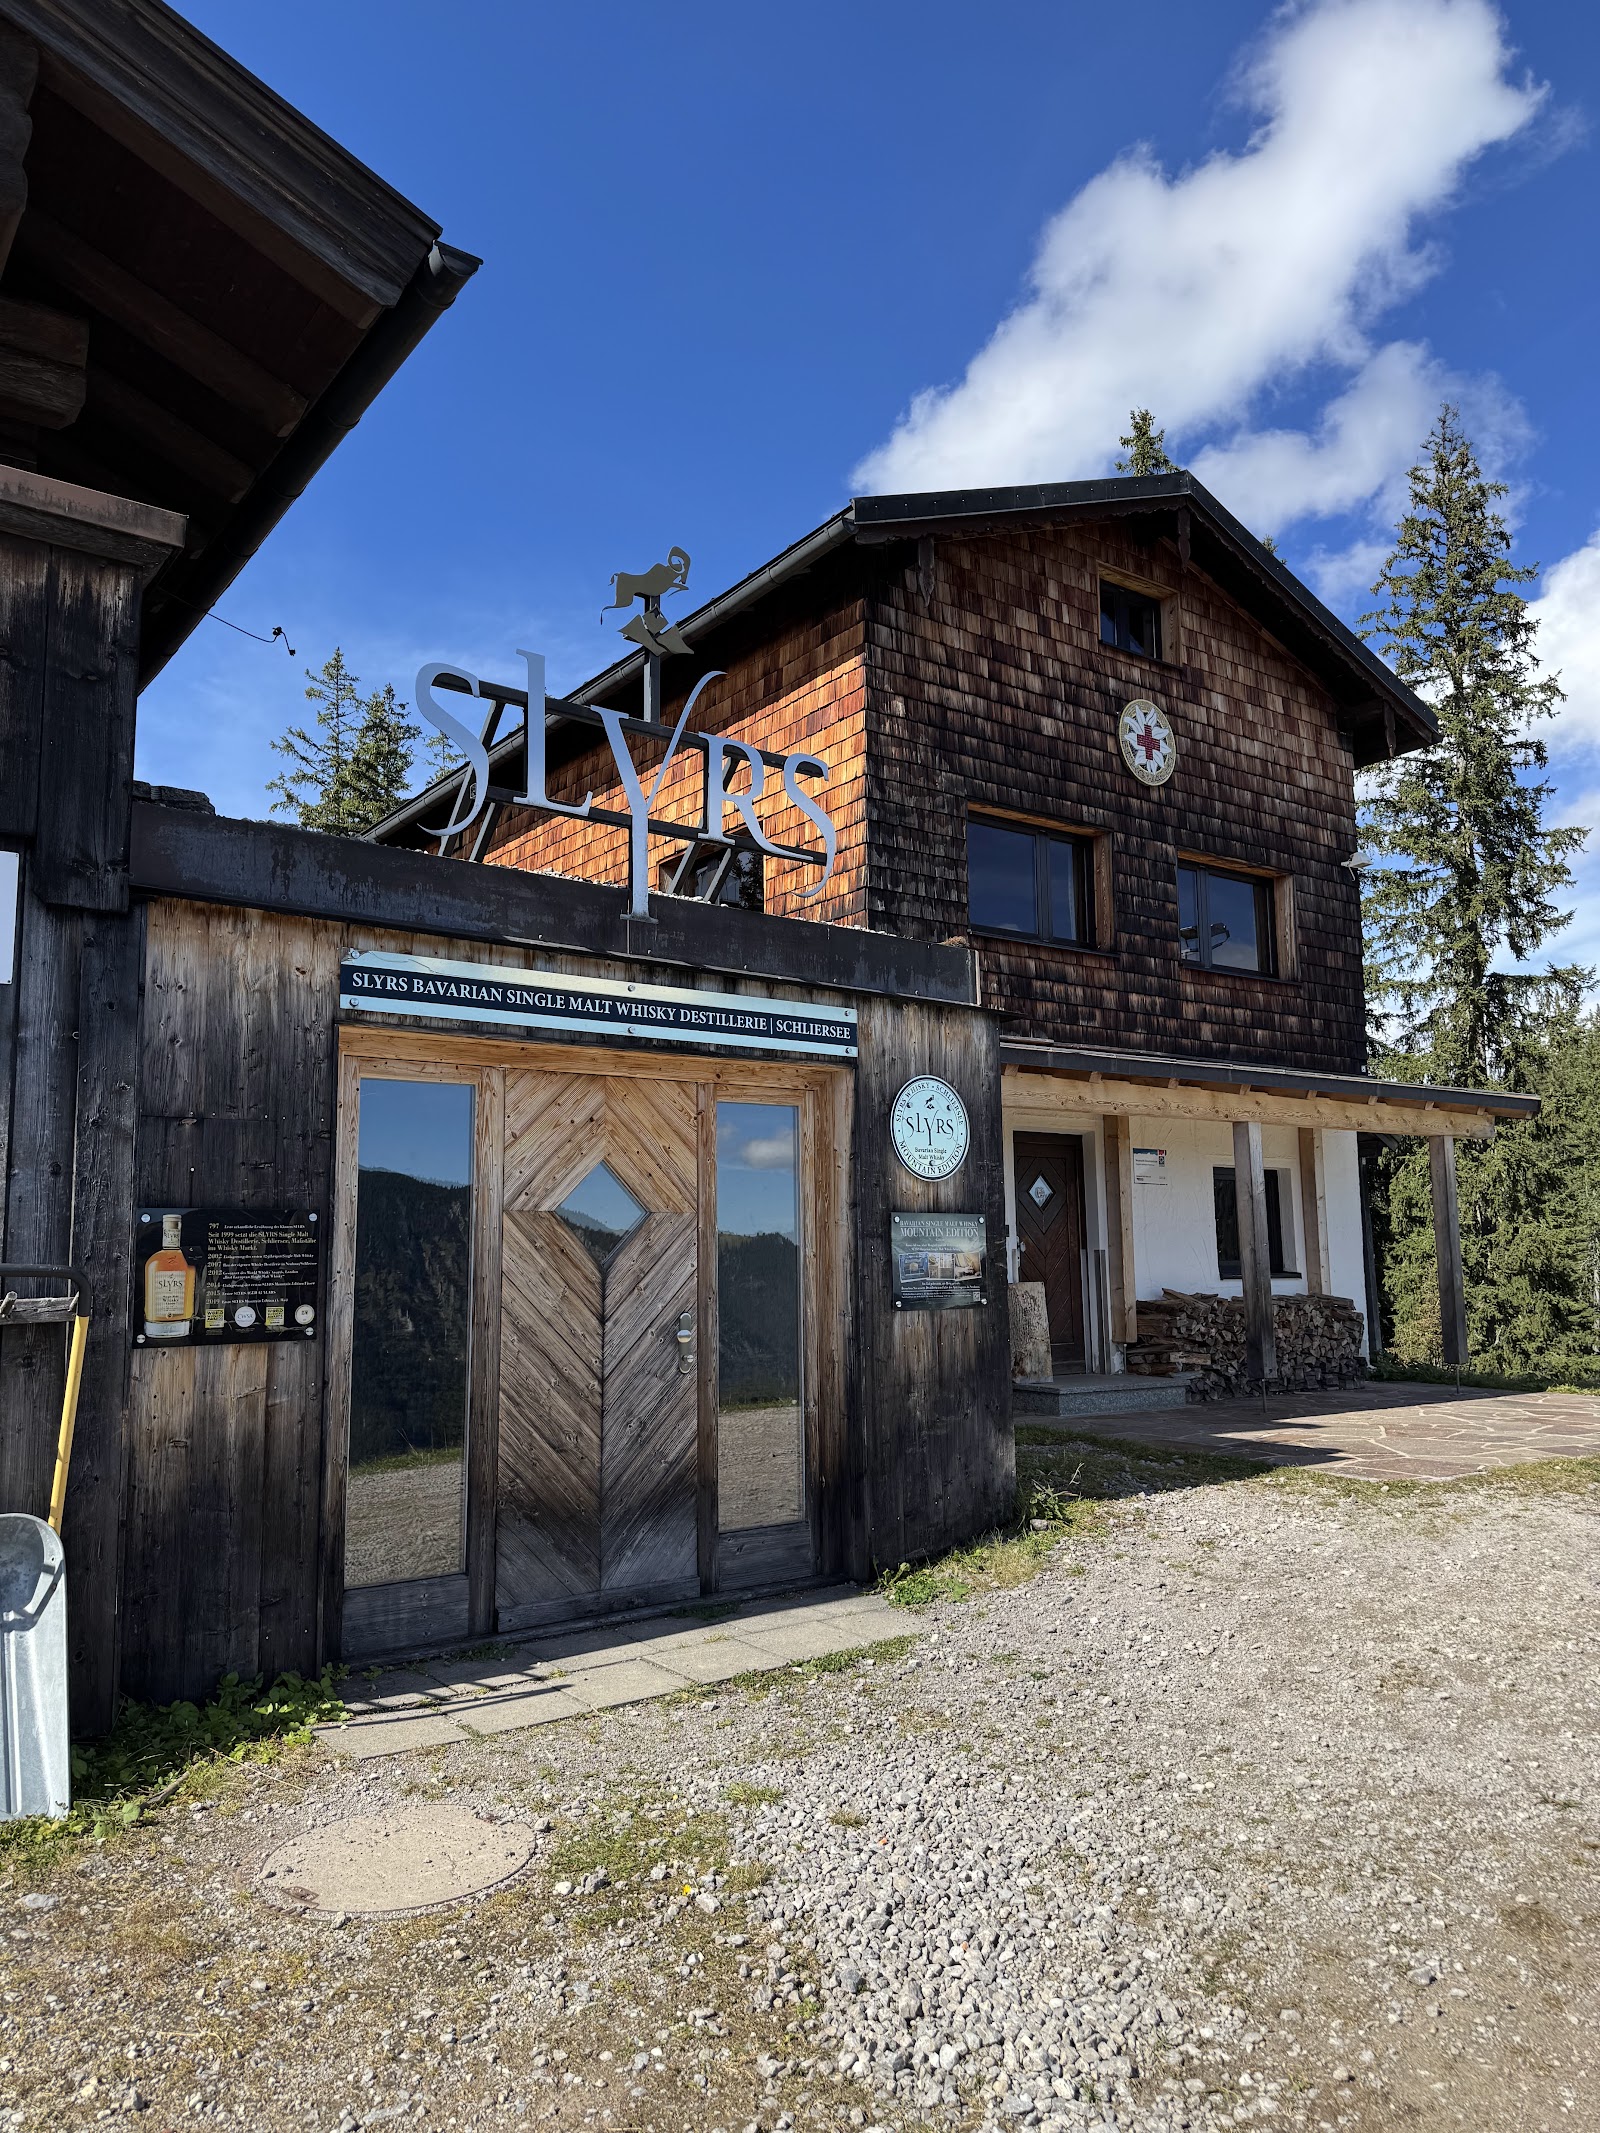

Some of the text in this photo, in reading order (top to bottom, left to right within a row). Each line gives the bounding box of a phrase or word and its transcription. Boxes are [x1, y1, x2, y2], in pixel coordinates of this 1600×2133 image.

[415, 649, 836, 924] SLYRS
[352, 972, 851, 1040] SLYRS BAVARIAN SINGLE MALT WHISKY DESTILLERIE SCHLIERSEE
[906, 1082, 930, 1098] WHISKY
[906, 1109, 954, 1146] SLYRS
[898, 1140, 962, 1174] MOUNTAIN EDITION
[900, 1228, 979, 1237] MOUNTAIN EDITION
[158, 1278, 183, 1291] SLYRS
